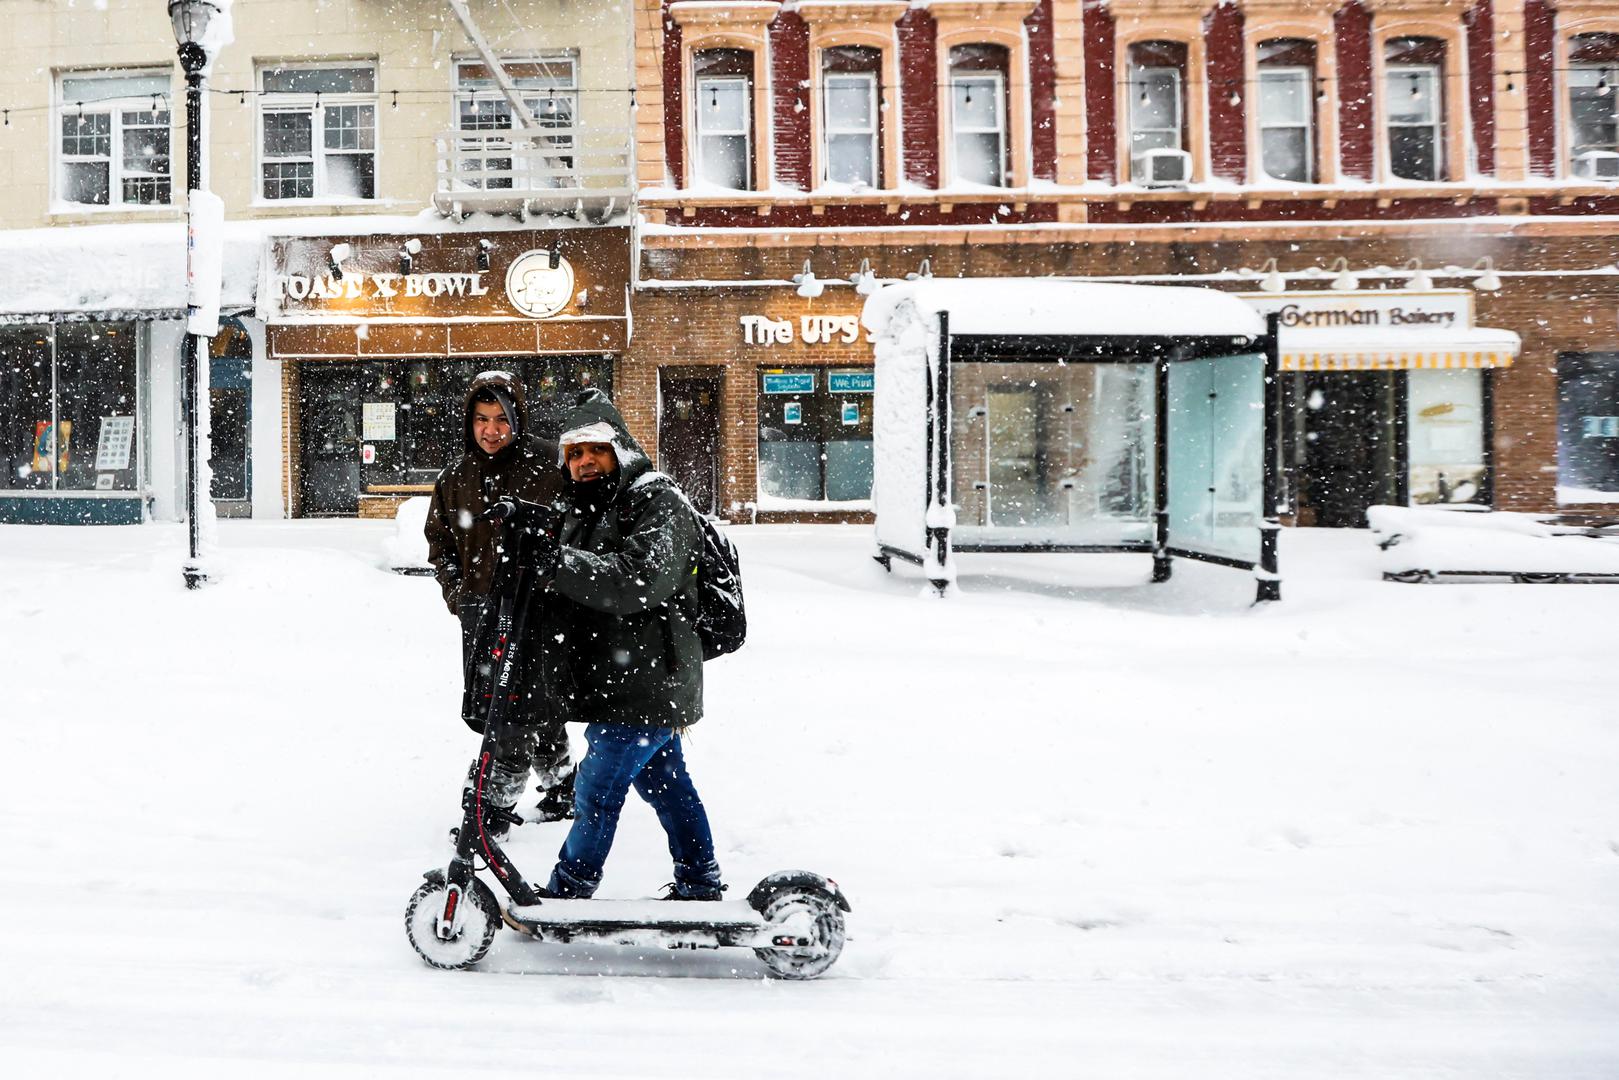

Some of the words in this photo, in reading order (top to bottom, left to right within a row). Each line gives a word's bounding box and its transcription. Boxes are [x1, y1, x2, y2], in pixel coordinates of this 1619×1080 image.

[276, 272, 364, 300] TOAST
[371, 273, 399, 298] X
[404, 273, 490, 298] BOWL
[739, 314, 794, 345] The
[800, 314, 860, 345] UPS
[1279, 303, 1380, 327] German
[1389, 307, 1455, 328] Bakery
[499, 659, 513, 687] hiboy
